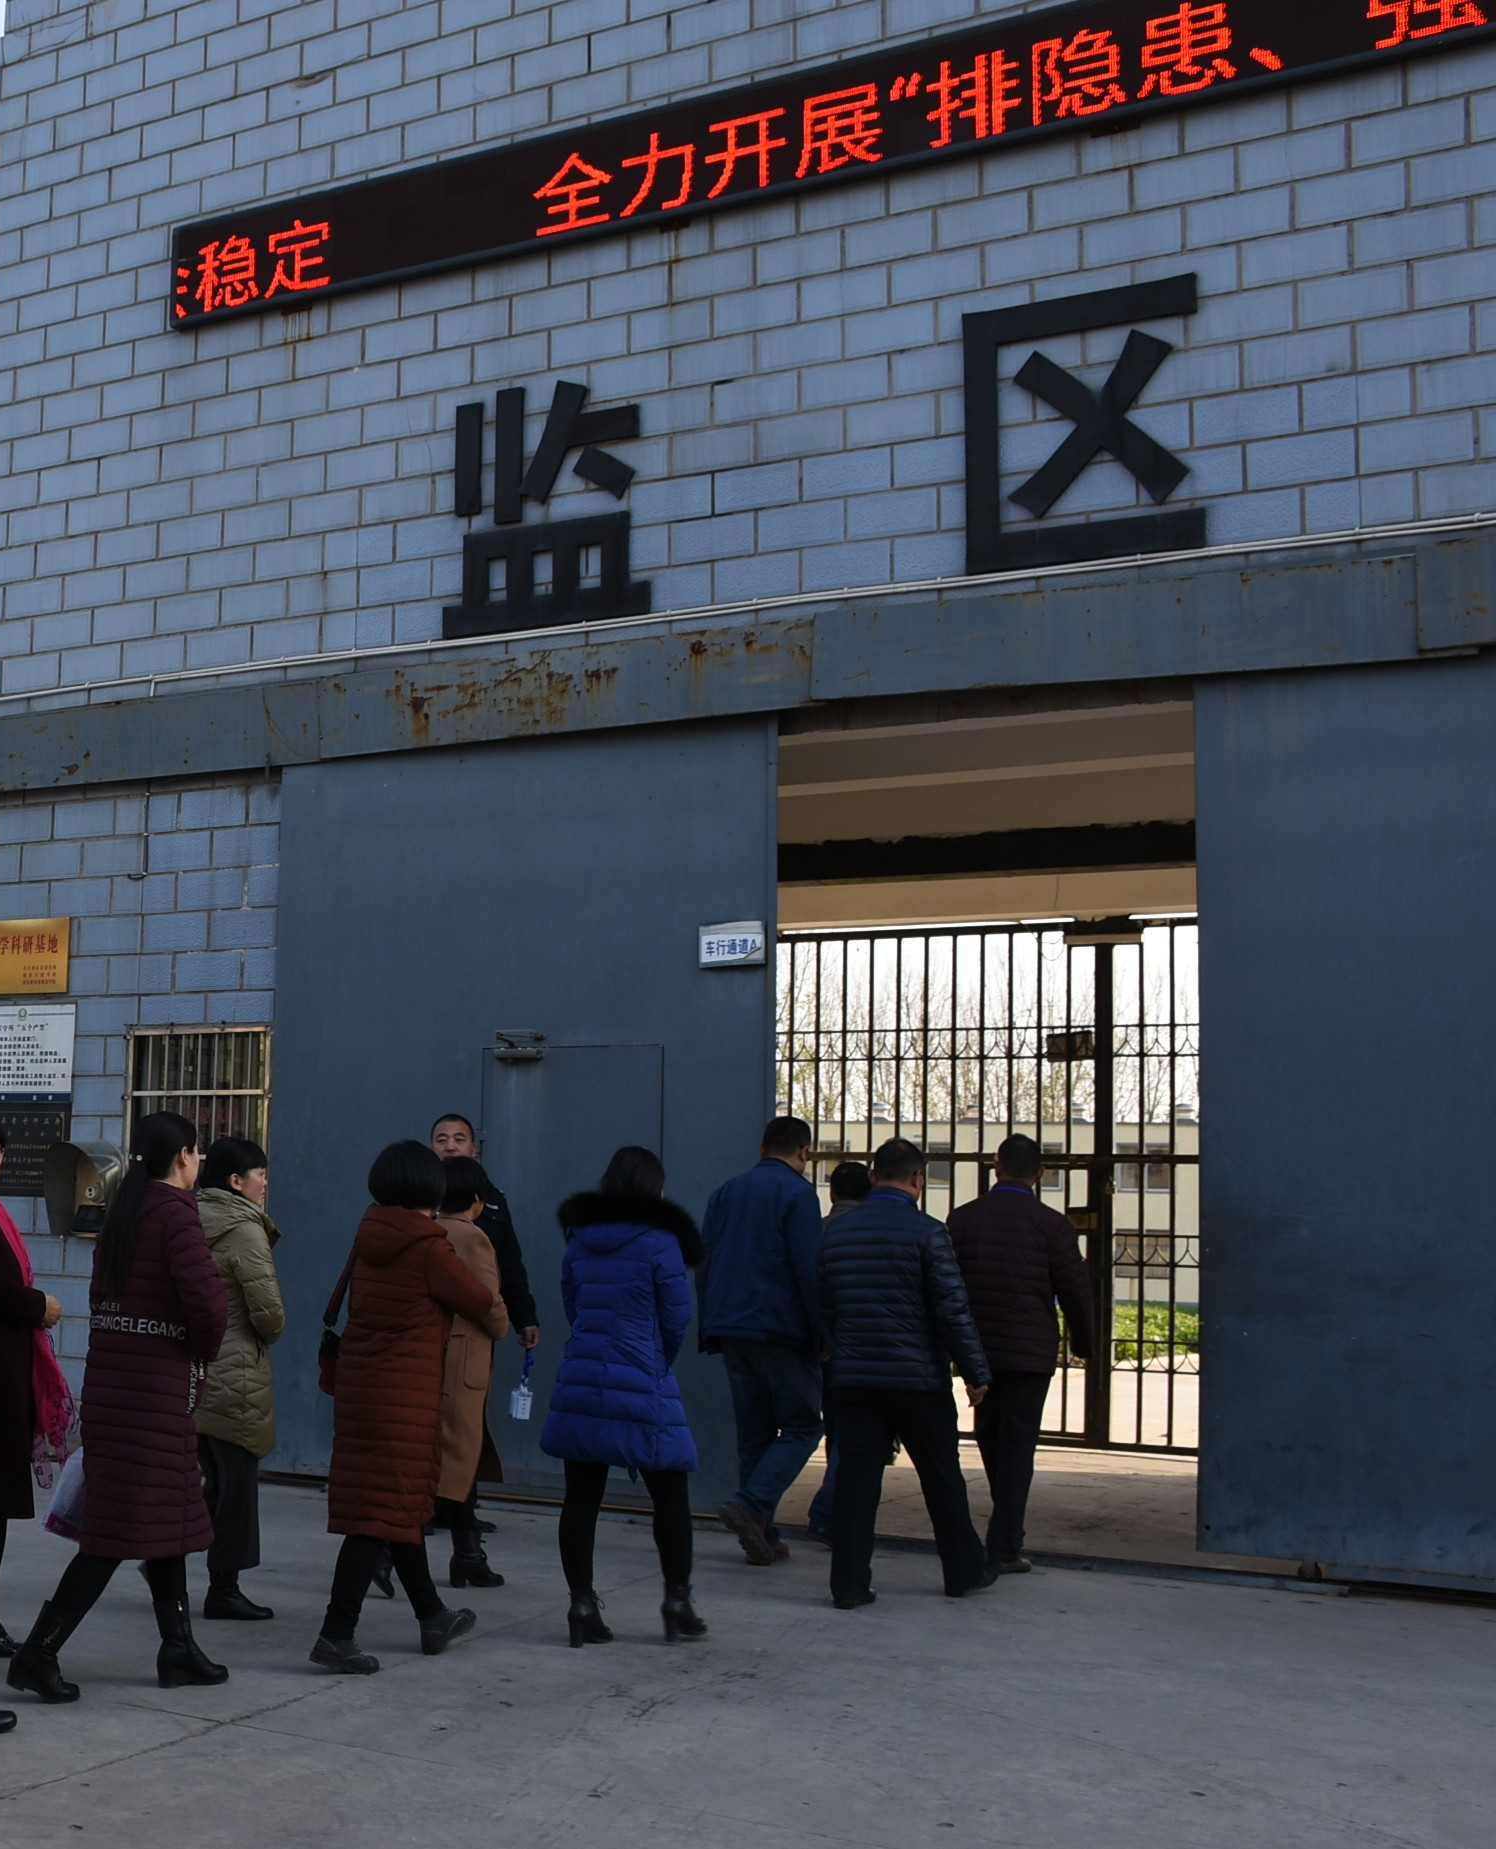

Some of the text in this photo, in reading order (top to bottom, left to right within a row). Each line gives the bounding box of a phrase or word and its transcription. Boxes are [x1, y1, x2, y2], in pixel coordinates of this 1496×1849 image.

[176, 218, 331, 319] 稳定
[443, 272, 1206, 640] 监区
[706, 938, 757, 957] 车行通道A
